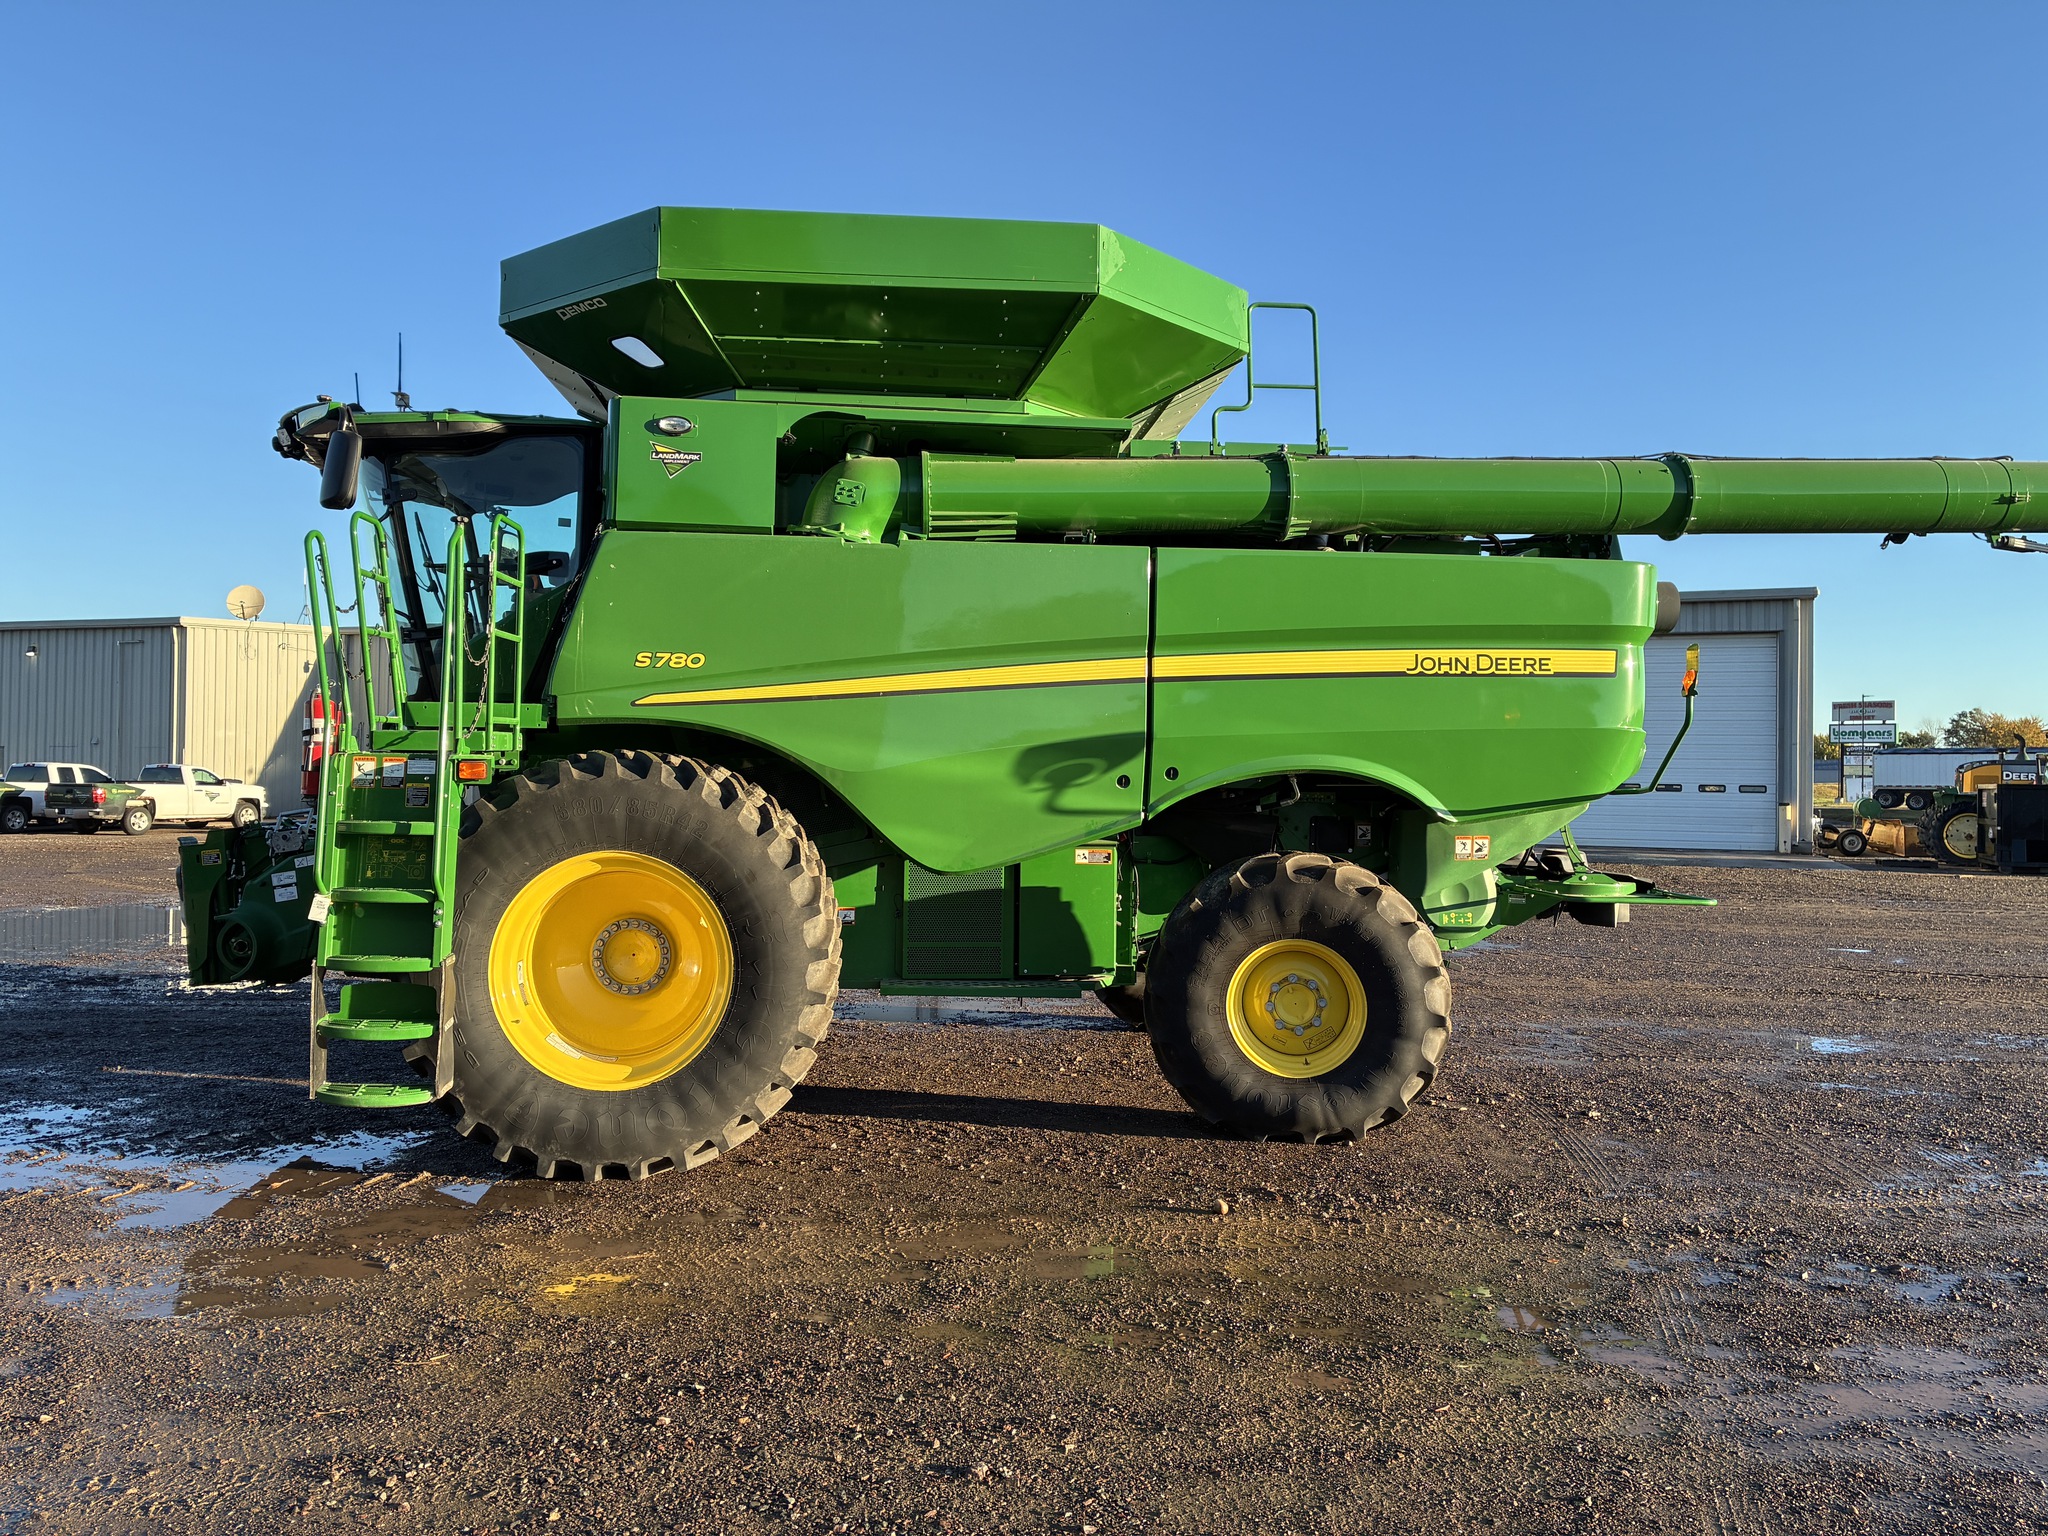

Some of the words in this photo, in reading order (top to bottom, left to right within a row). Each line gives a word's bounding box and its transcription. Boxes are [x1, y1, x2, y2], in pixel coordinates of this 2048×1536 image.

[556, 297, 607, 321] DEMCO
[633, 651, 706, 669] S780
[1406, 653, 1470, 672] JOHN
[1476, 653, 1551, 672] DEERE
[1832, 728, 1893, 739] bomgaars
[2002, 771, 2037, 781] DEER
[552, 795, 710, 841] 580/85R42
[1232, 905, 1270, 933] DT
